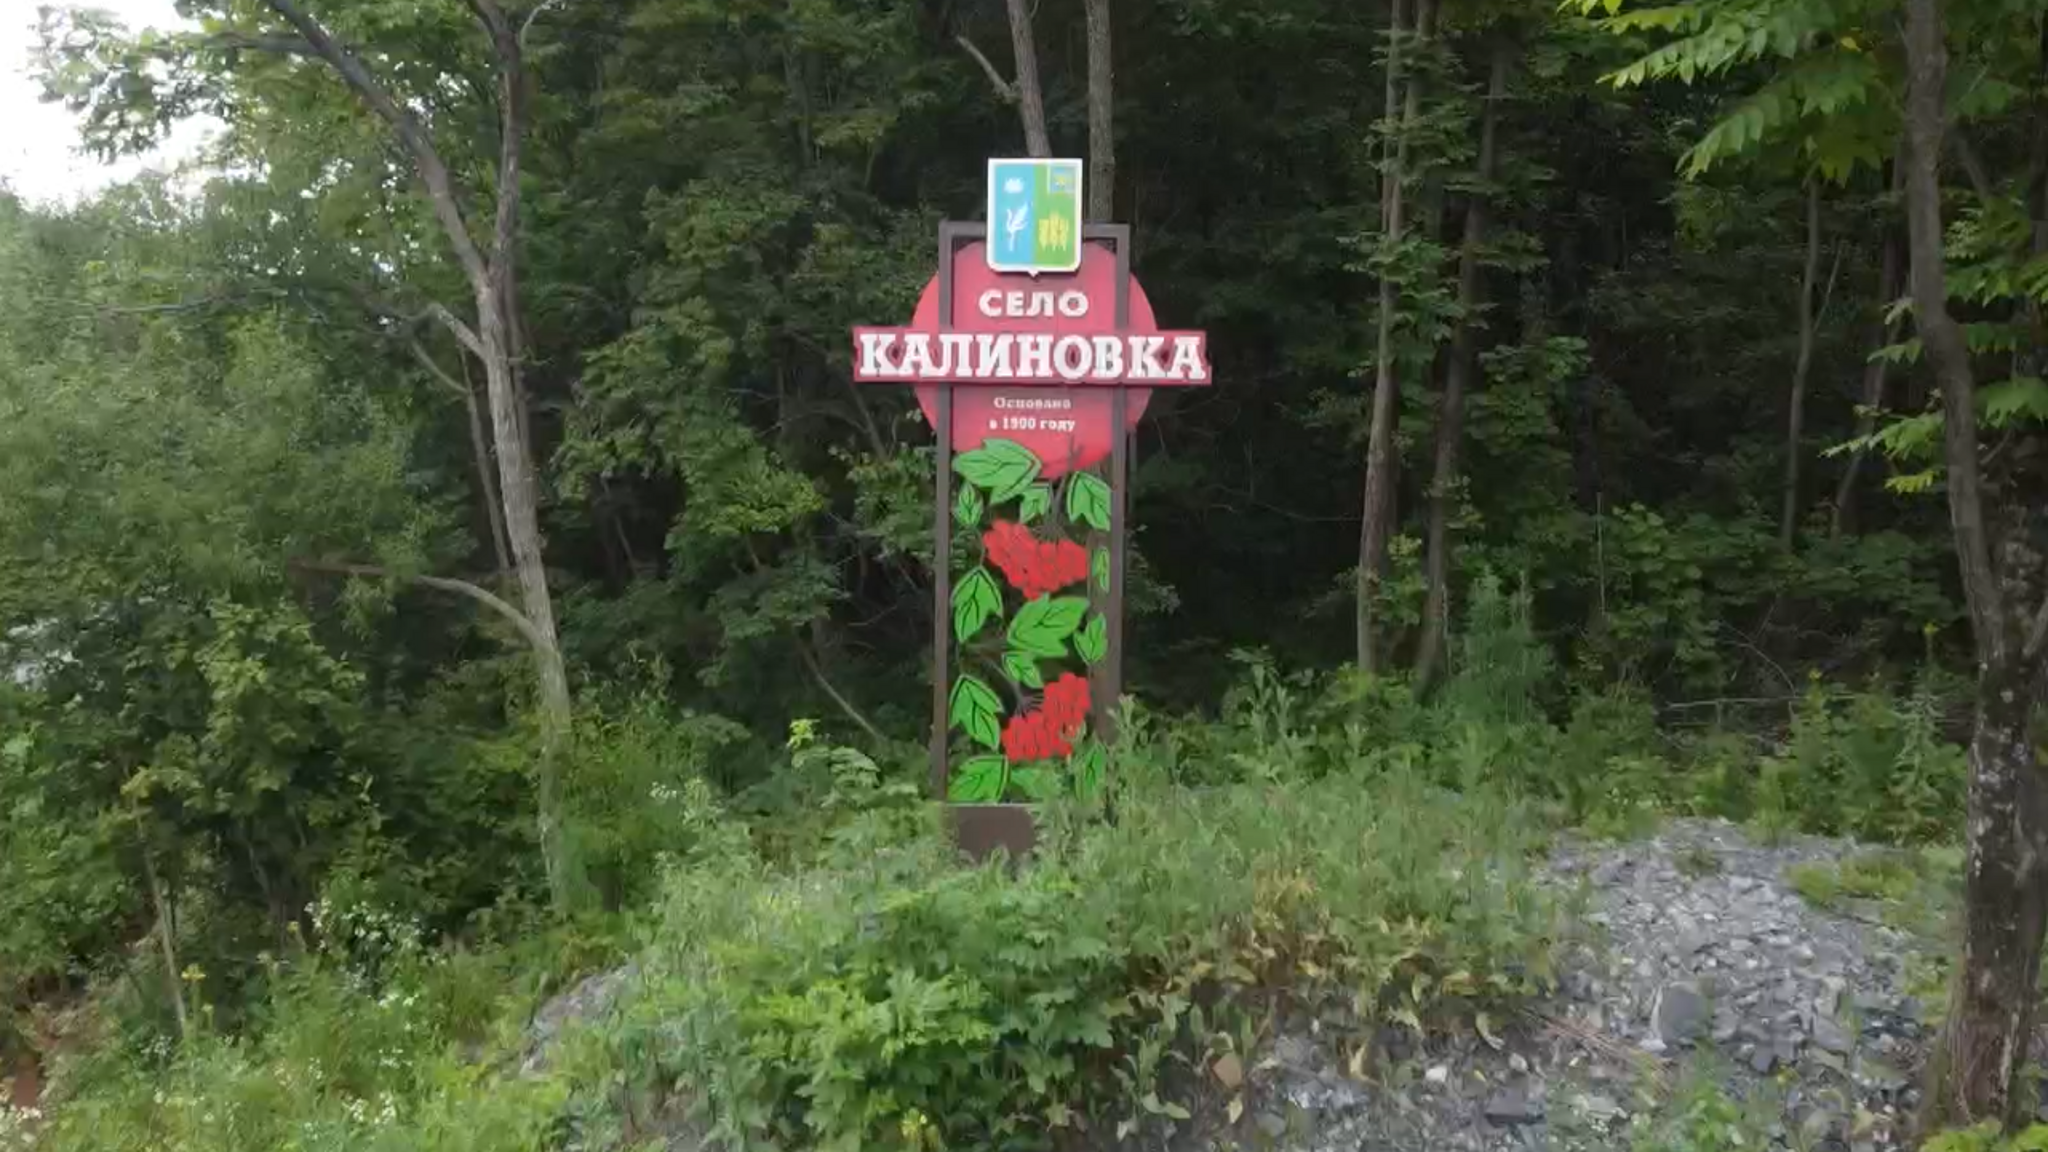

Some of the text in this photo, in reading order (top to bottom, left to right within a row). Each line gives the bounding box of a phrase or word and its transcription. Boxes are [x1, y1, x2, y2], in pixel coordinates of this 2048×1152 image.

[978, 289, 1090, 318] СЕЛО
[859, 333, 1207, 380] КАЛИНОВКА
[1040, 419, 1076, 433] году
